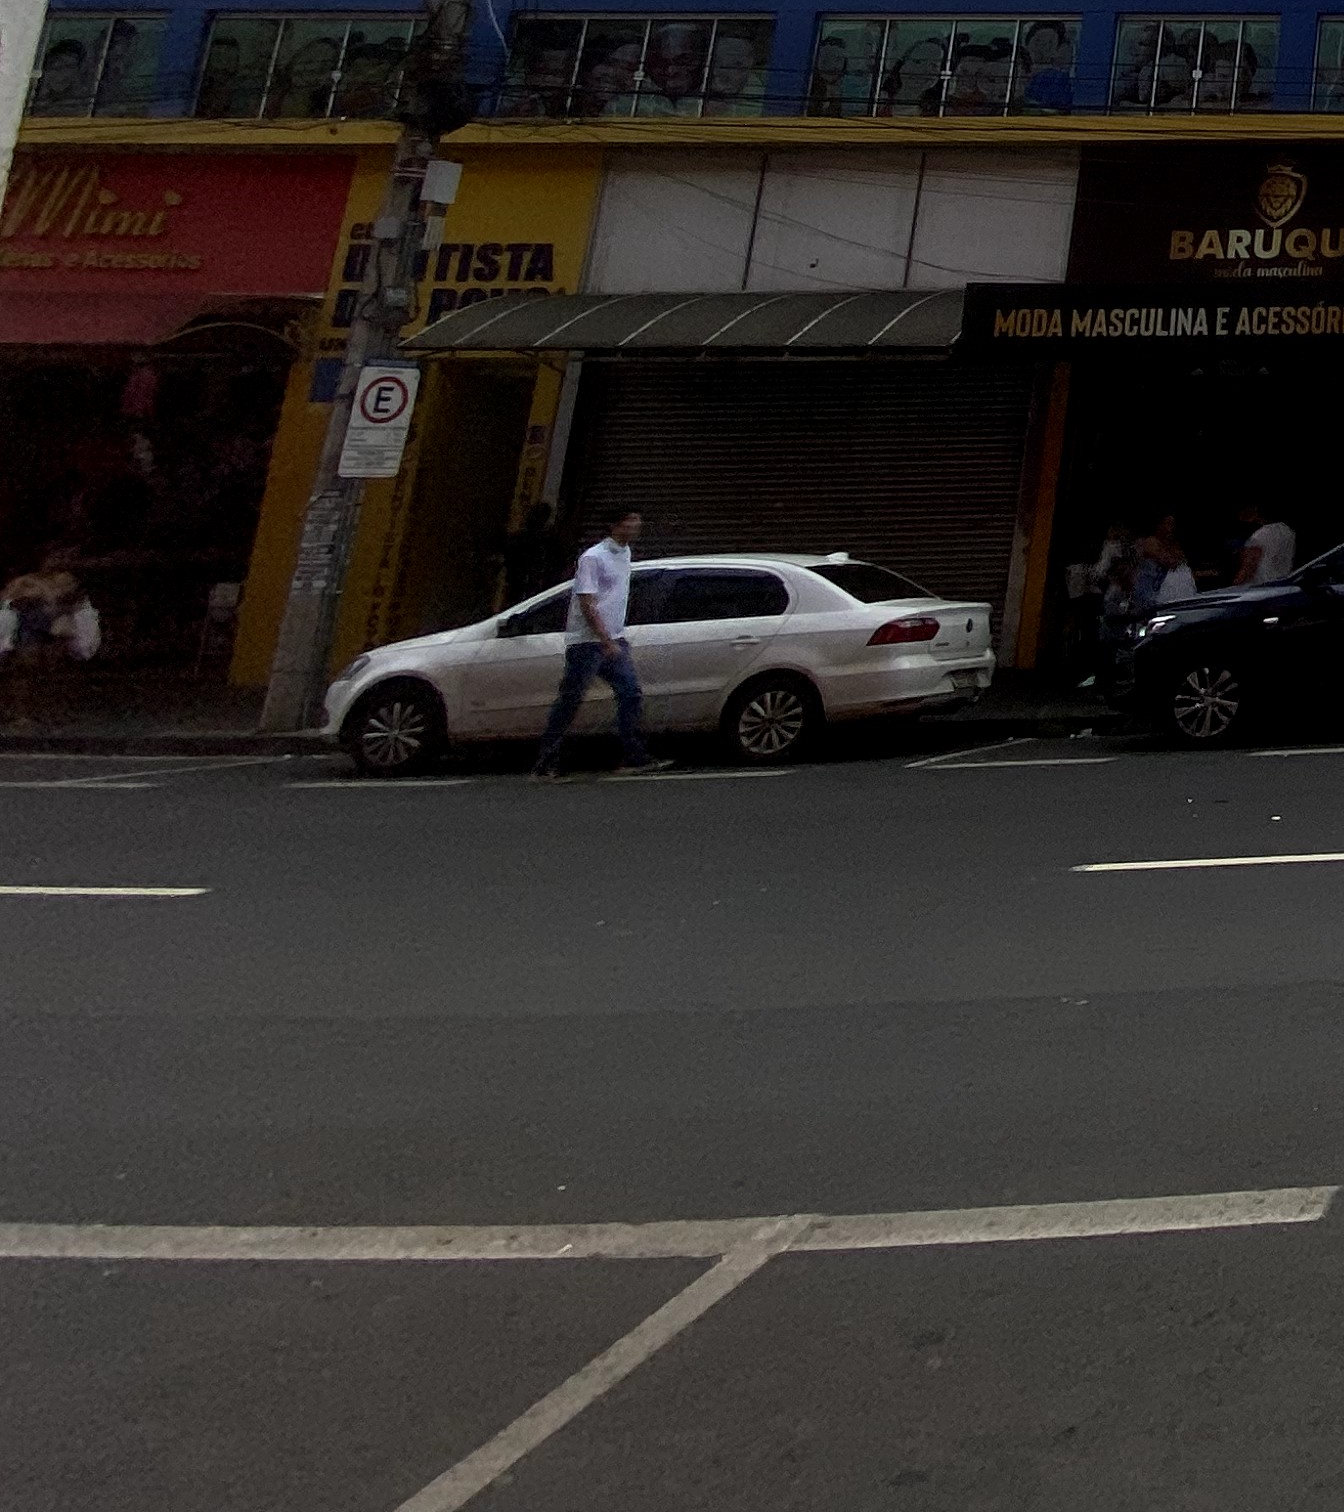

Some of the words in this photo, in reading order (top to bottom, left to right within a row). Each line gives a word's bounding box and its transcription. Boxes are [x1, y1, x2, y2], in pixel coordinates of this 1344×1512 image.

[343, 242, 554, 282] DTISTA
[993, 308, 1063, 338] MODA
[1070, 307, 1209, 338] MASCULINA
[1215, 306, 1230, 337] E
[373, 386, 395, 413] E
